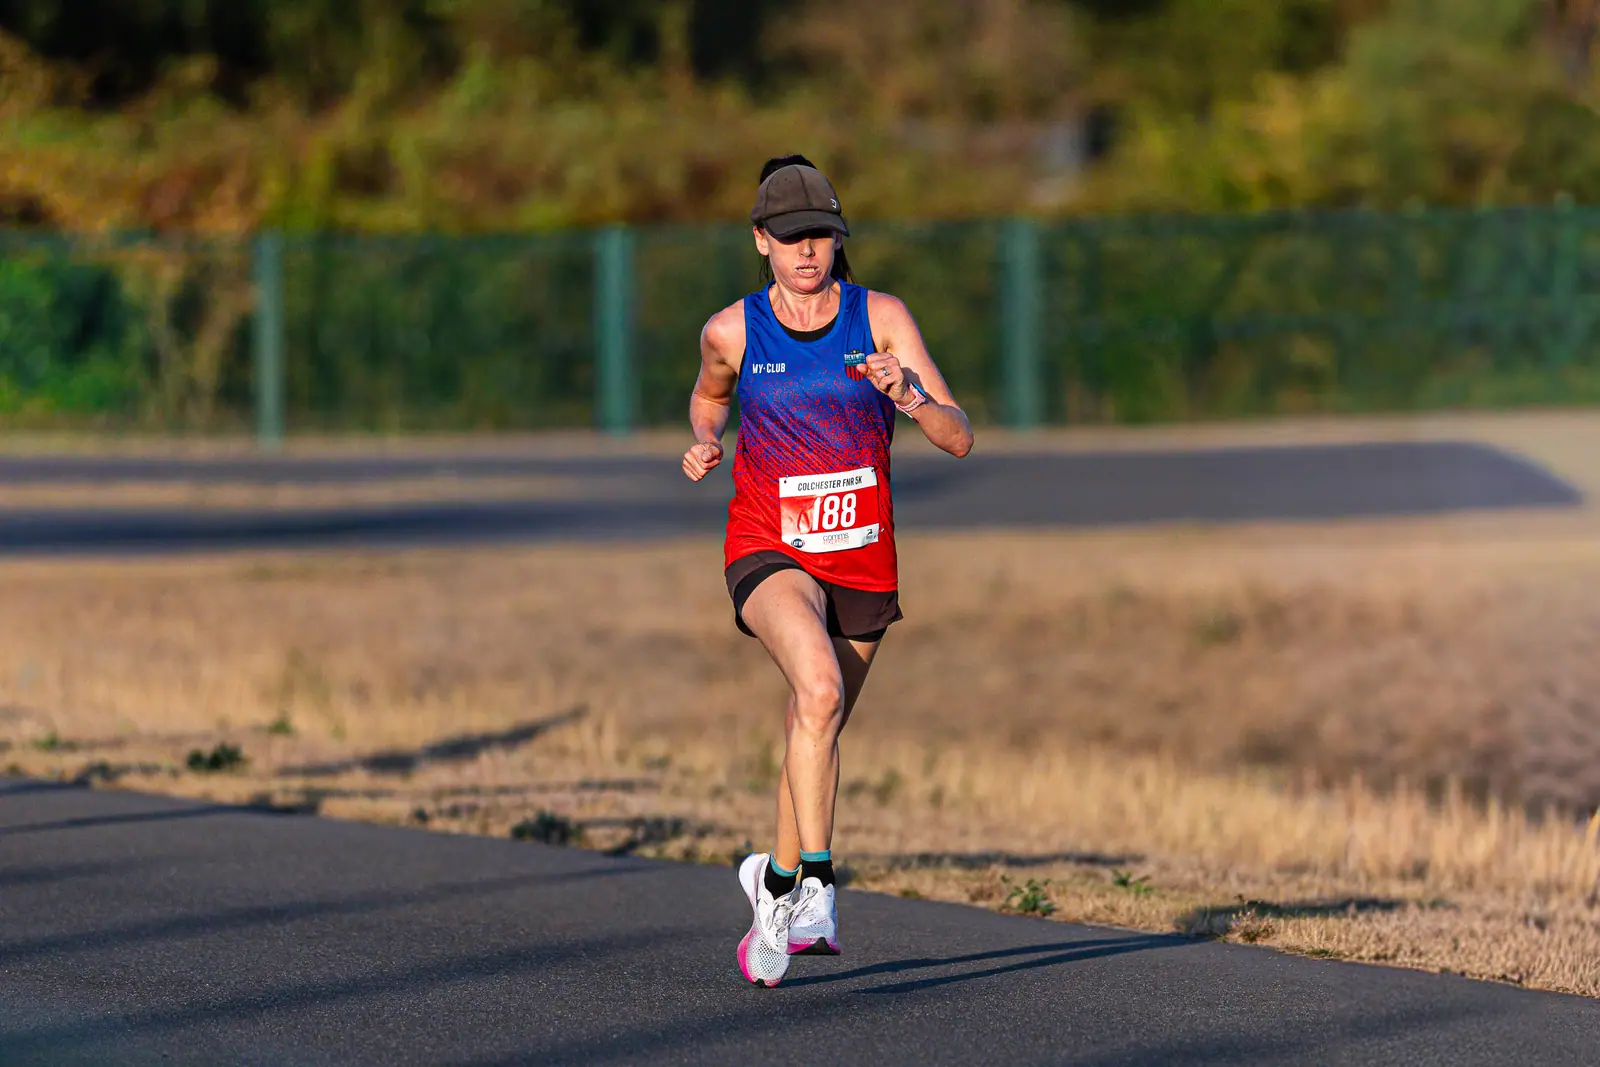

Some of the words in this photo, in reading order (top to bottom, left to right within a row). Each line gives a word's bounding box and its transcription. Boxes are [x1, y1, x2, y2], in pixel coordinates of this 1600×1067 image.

[798, 480, 841, 491] COLCHESTER
[842, 478, 855, 487] FNR
[855, 476, 863, 485] 5K
[812, 493, 857, 531] 188
